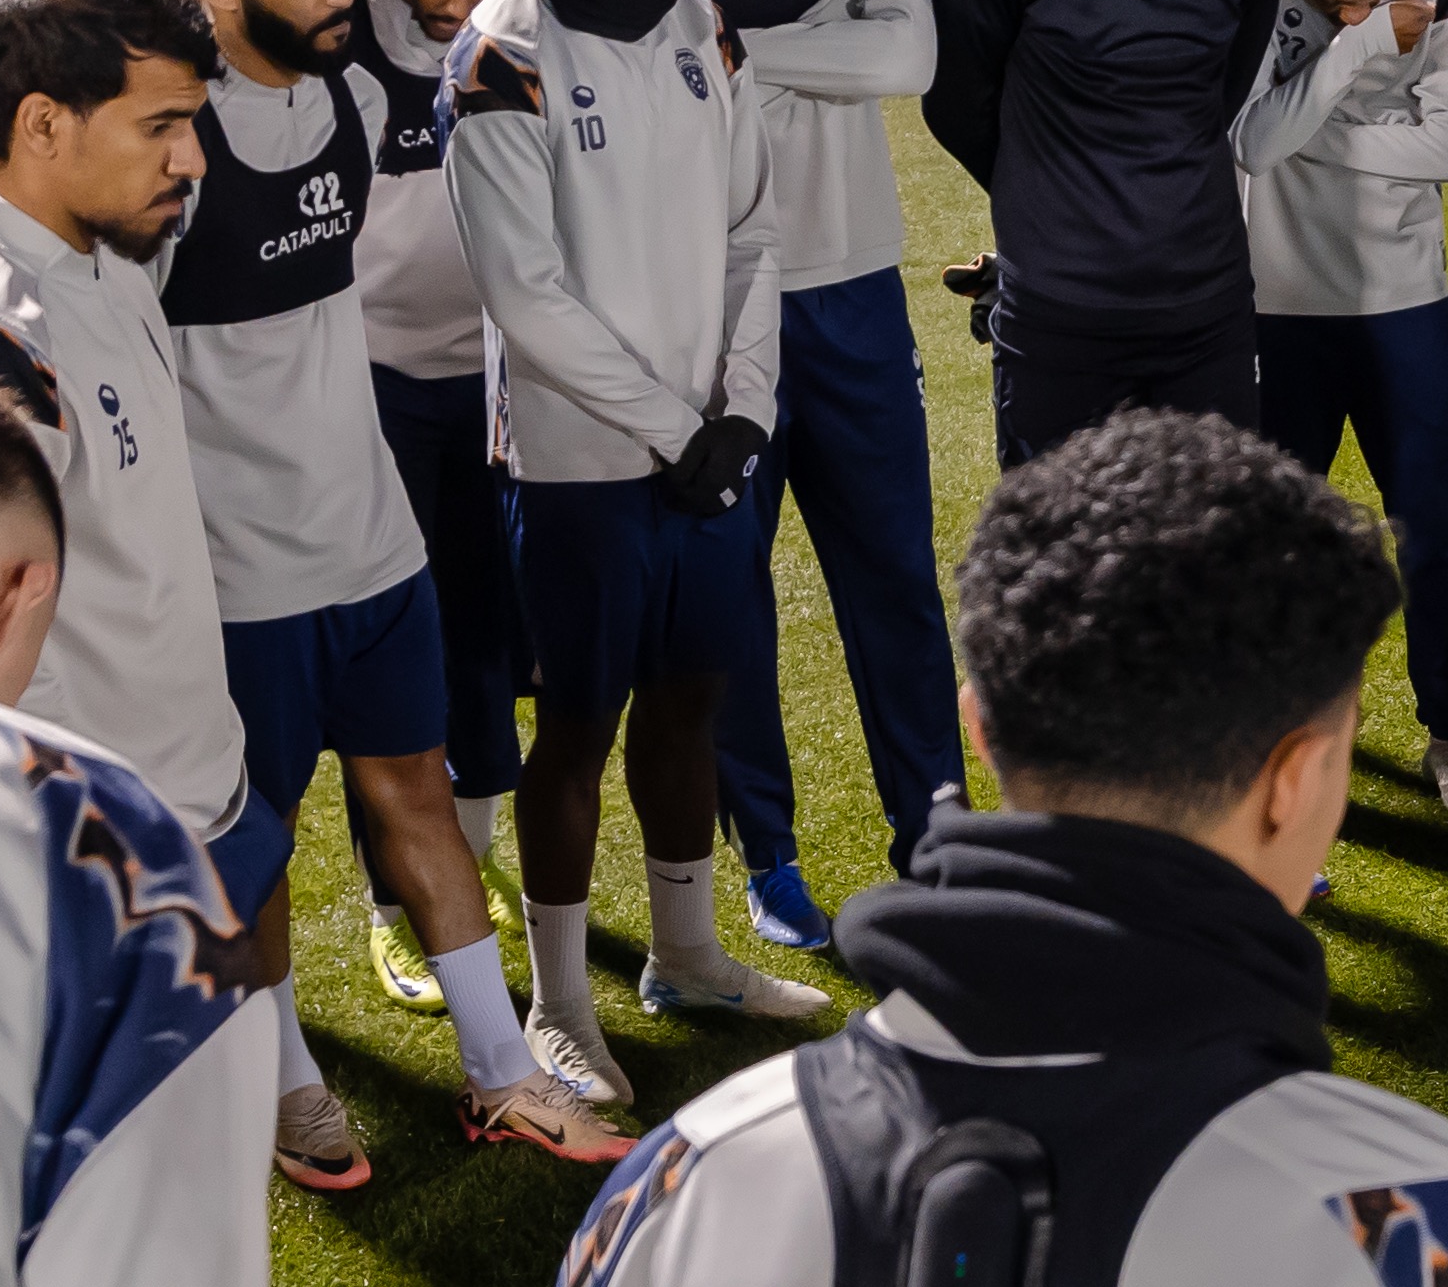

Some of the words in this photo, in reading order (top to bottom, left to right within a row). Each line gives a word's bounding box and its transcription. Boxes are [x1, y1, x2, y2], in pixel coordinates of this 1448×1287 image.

[398, 126, 436, 148] CA
[571, 115, 607, 152] 10
[309, 171, 345, 215] 22
[259, 210, 353, 262] CATAPULT
[112, 417, 139, 470] 15
